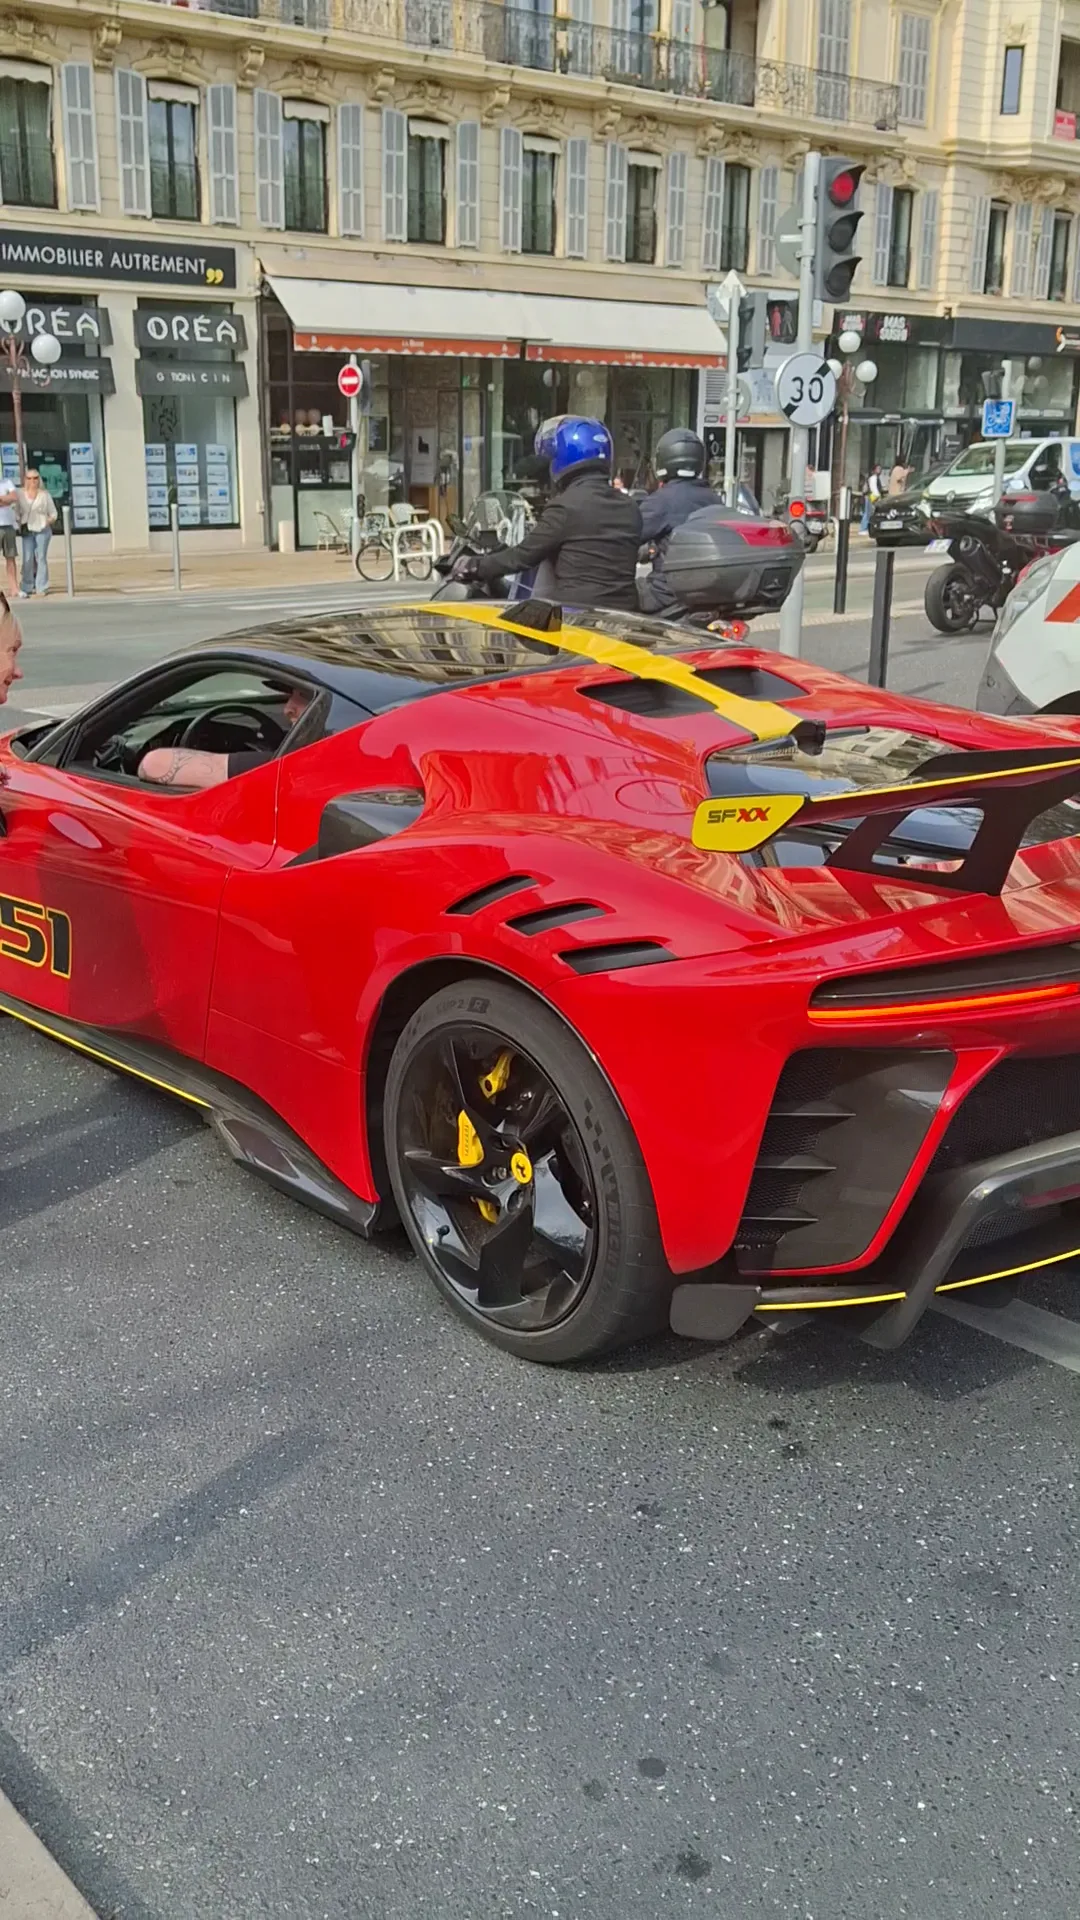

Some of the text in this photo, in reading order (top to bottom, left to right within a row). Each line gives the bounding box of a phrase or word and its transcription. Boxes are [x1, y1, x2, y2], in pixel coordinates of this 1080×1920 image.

[2, 243, 103, 267] IMMOBILIER
[147, 314, 238, 343] ORÉA
[790, 376, 823, 403] 30
[0, 892, 71, 979] 51
